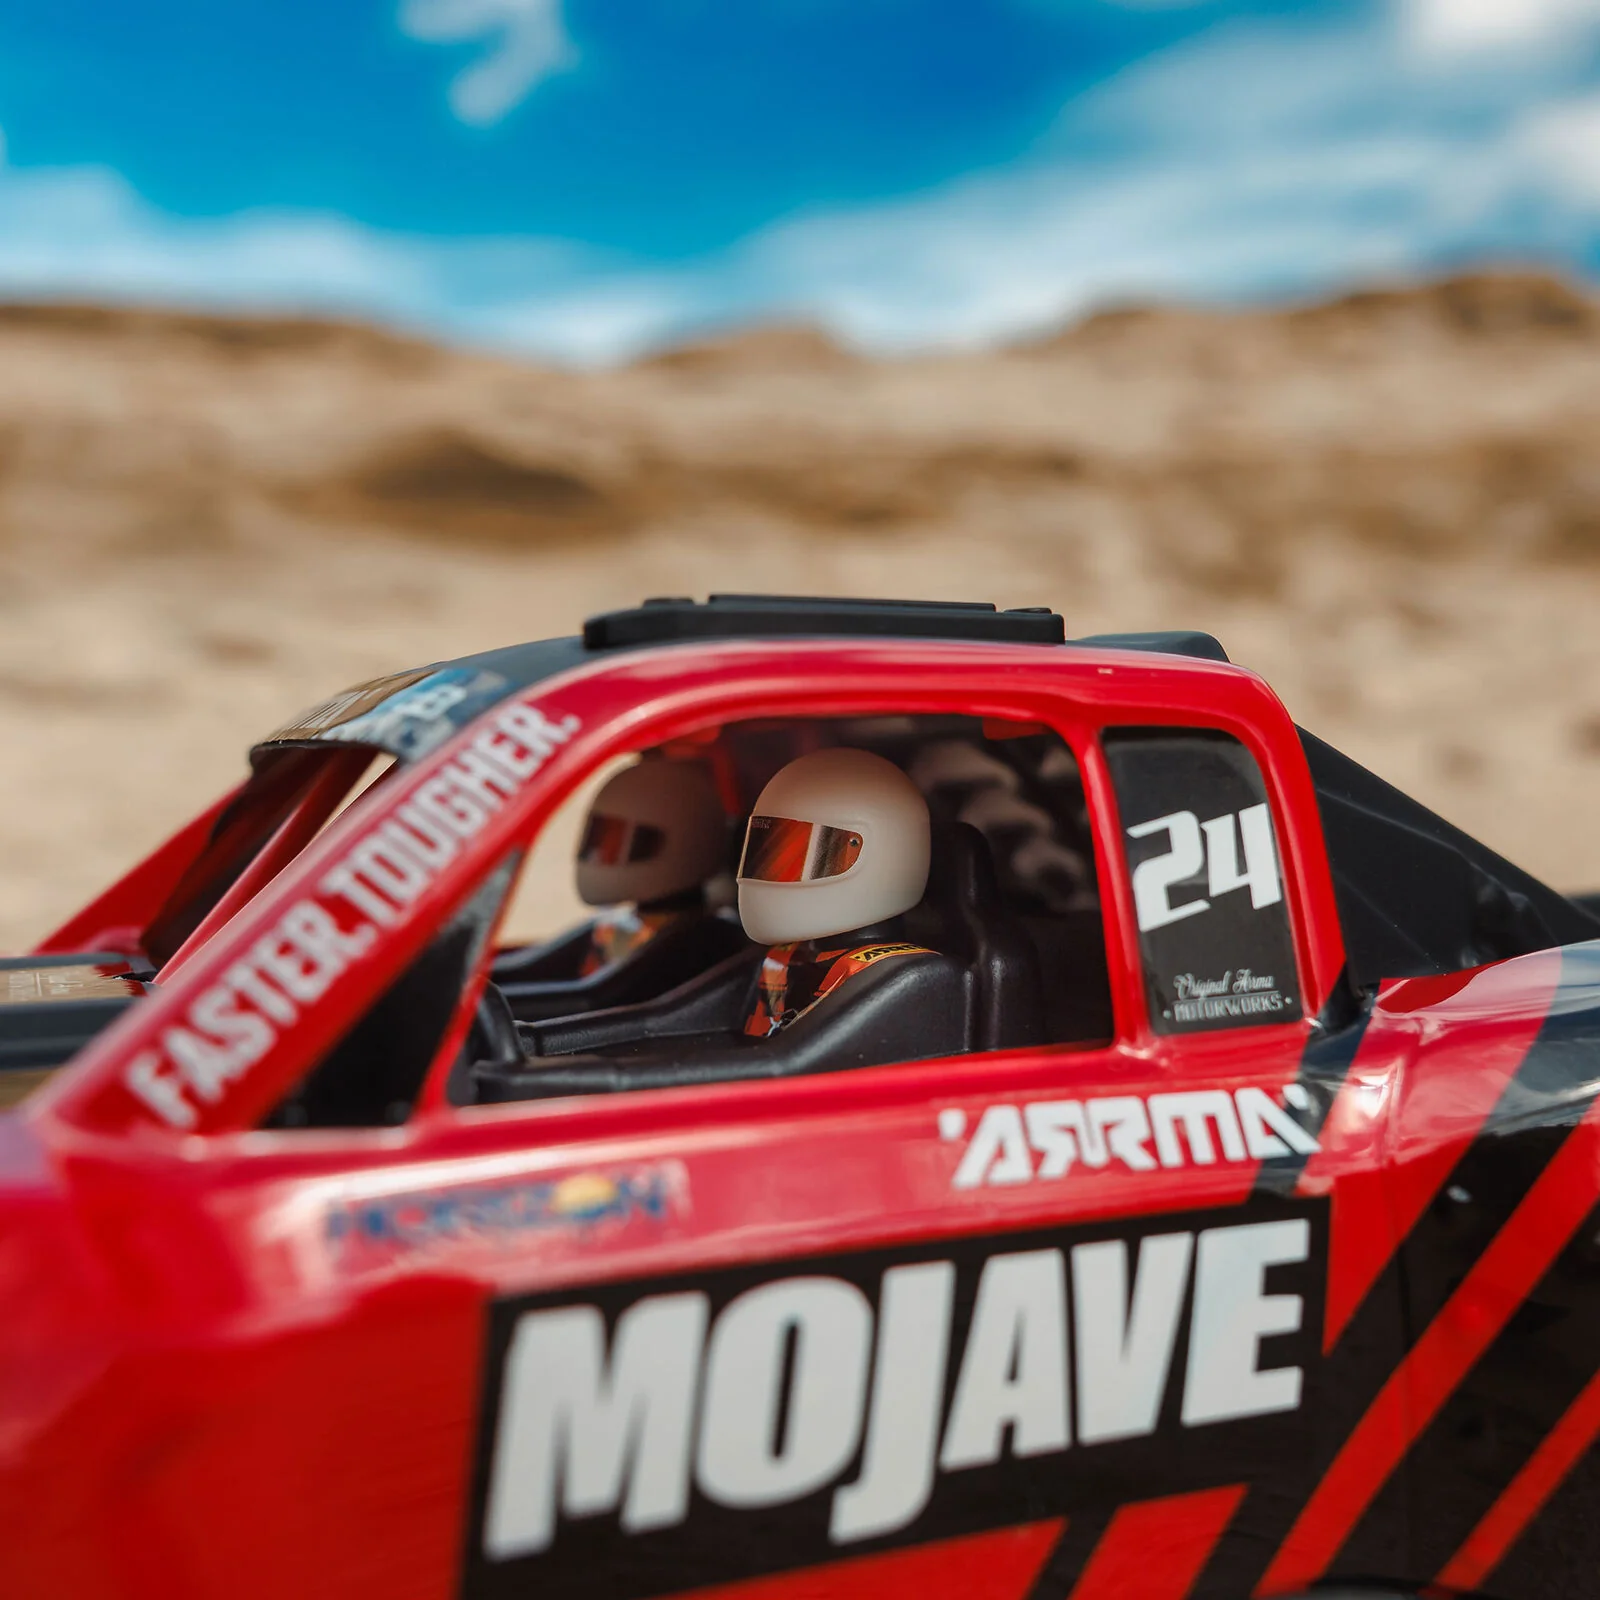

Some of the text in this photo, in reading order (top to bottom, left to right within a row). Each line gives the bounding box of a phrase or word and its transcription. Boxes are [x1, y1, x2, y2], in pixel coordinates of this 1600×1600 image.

[124, 702, 582, 1128] FASTER. TOUGHER.
[1126, 802, 1282, 933] 24
[1173, 971, 1232, 1000] Original
[938, 1084, 1322, 1190] ARRMA
[485, 1220, 1309, 1558] MOJAVE
